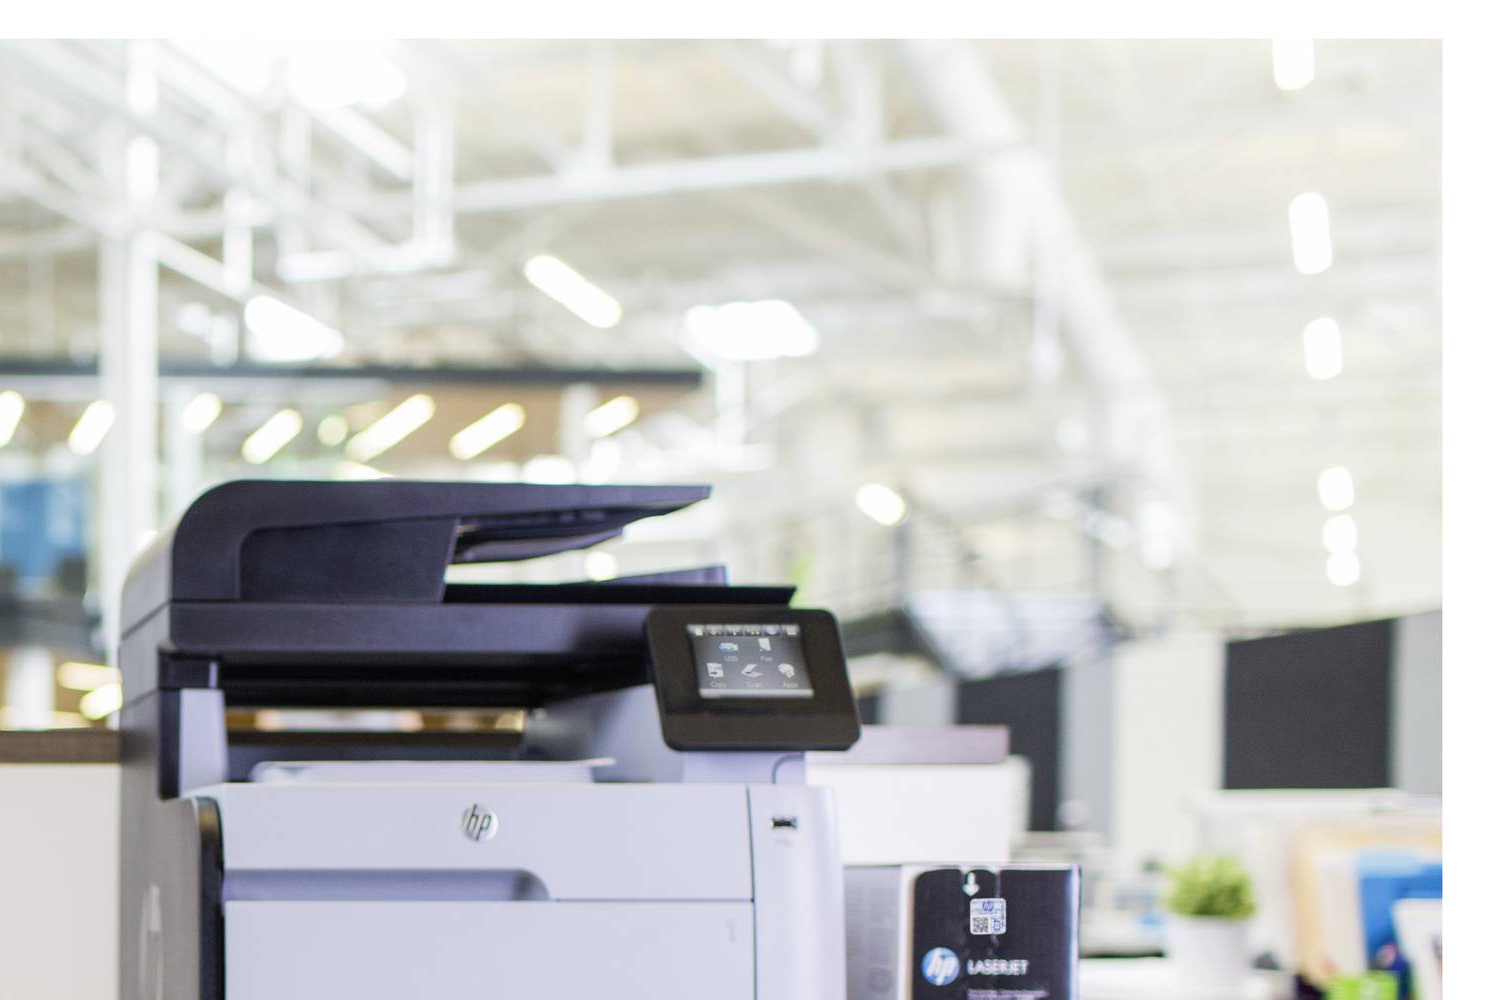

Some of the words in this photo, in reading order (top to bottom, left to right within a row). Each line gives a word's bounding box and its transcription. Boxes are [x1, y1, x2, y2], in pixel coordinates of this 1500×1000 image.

[464, 803, 494, 842] hp
[926, 947, 956, 986] hp
[966, 959, 1029, 975] LASERJET
